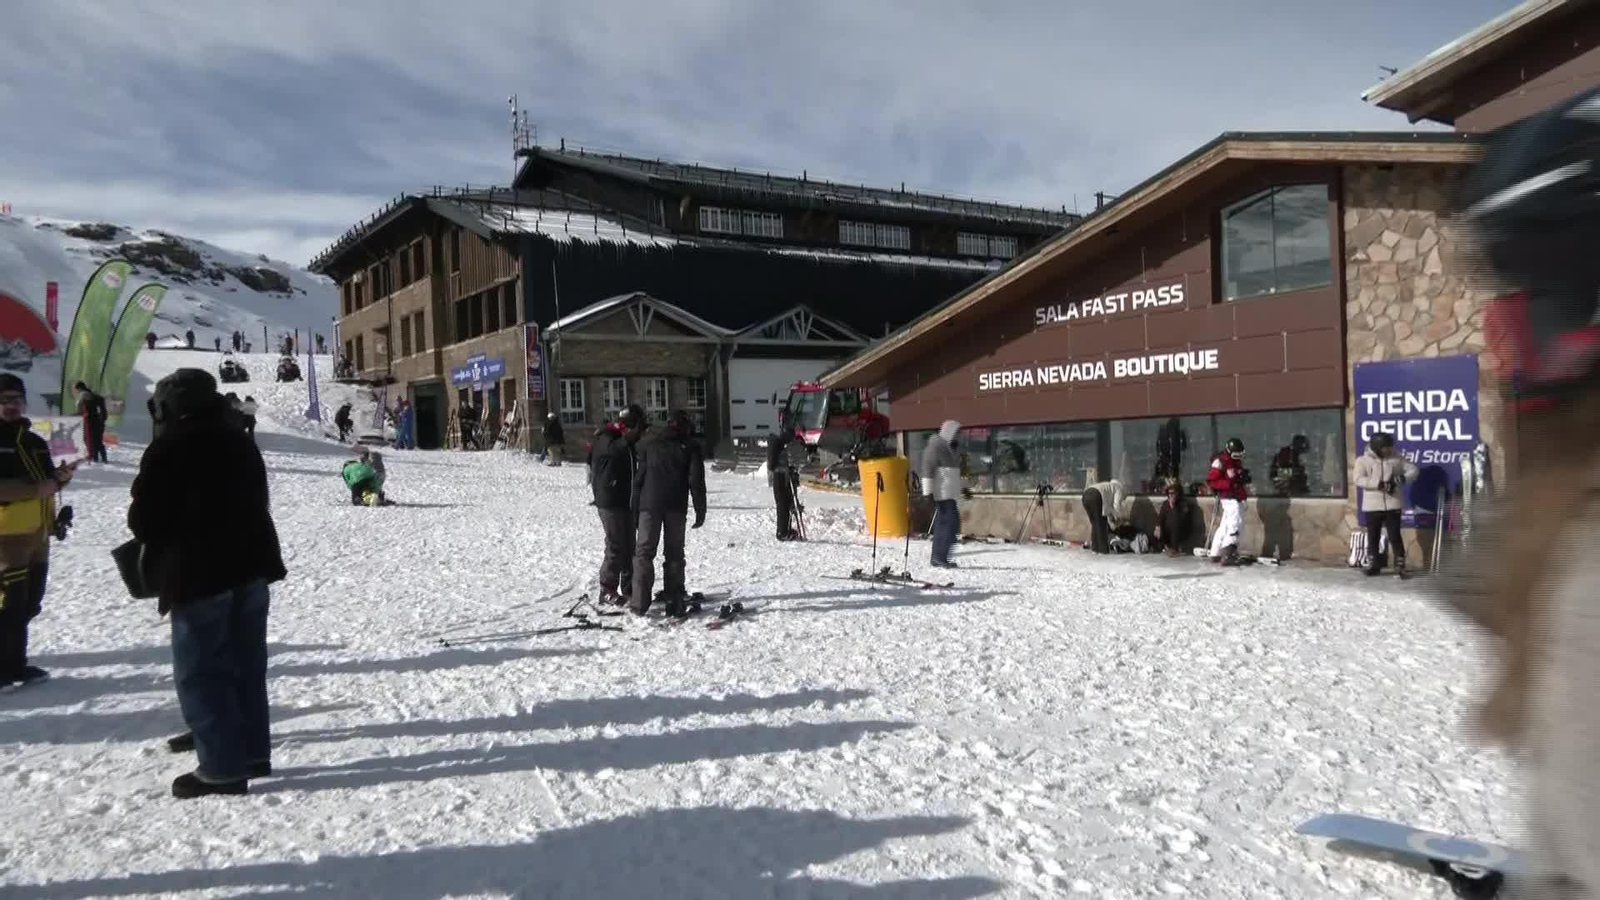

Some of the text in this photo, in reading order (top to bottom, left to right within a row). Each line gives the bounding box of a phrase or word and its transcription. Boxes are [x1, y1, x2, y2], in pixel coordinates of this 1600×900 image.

[1035, 284, 1184, 325] SALA FAST PASS
[979, 349, 1219, 390] SIERRA NEVADA BOUTIQUE
[1361, 389, 1469, 414] TIENDA
